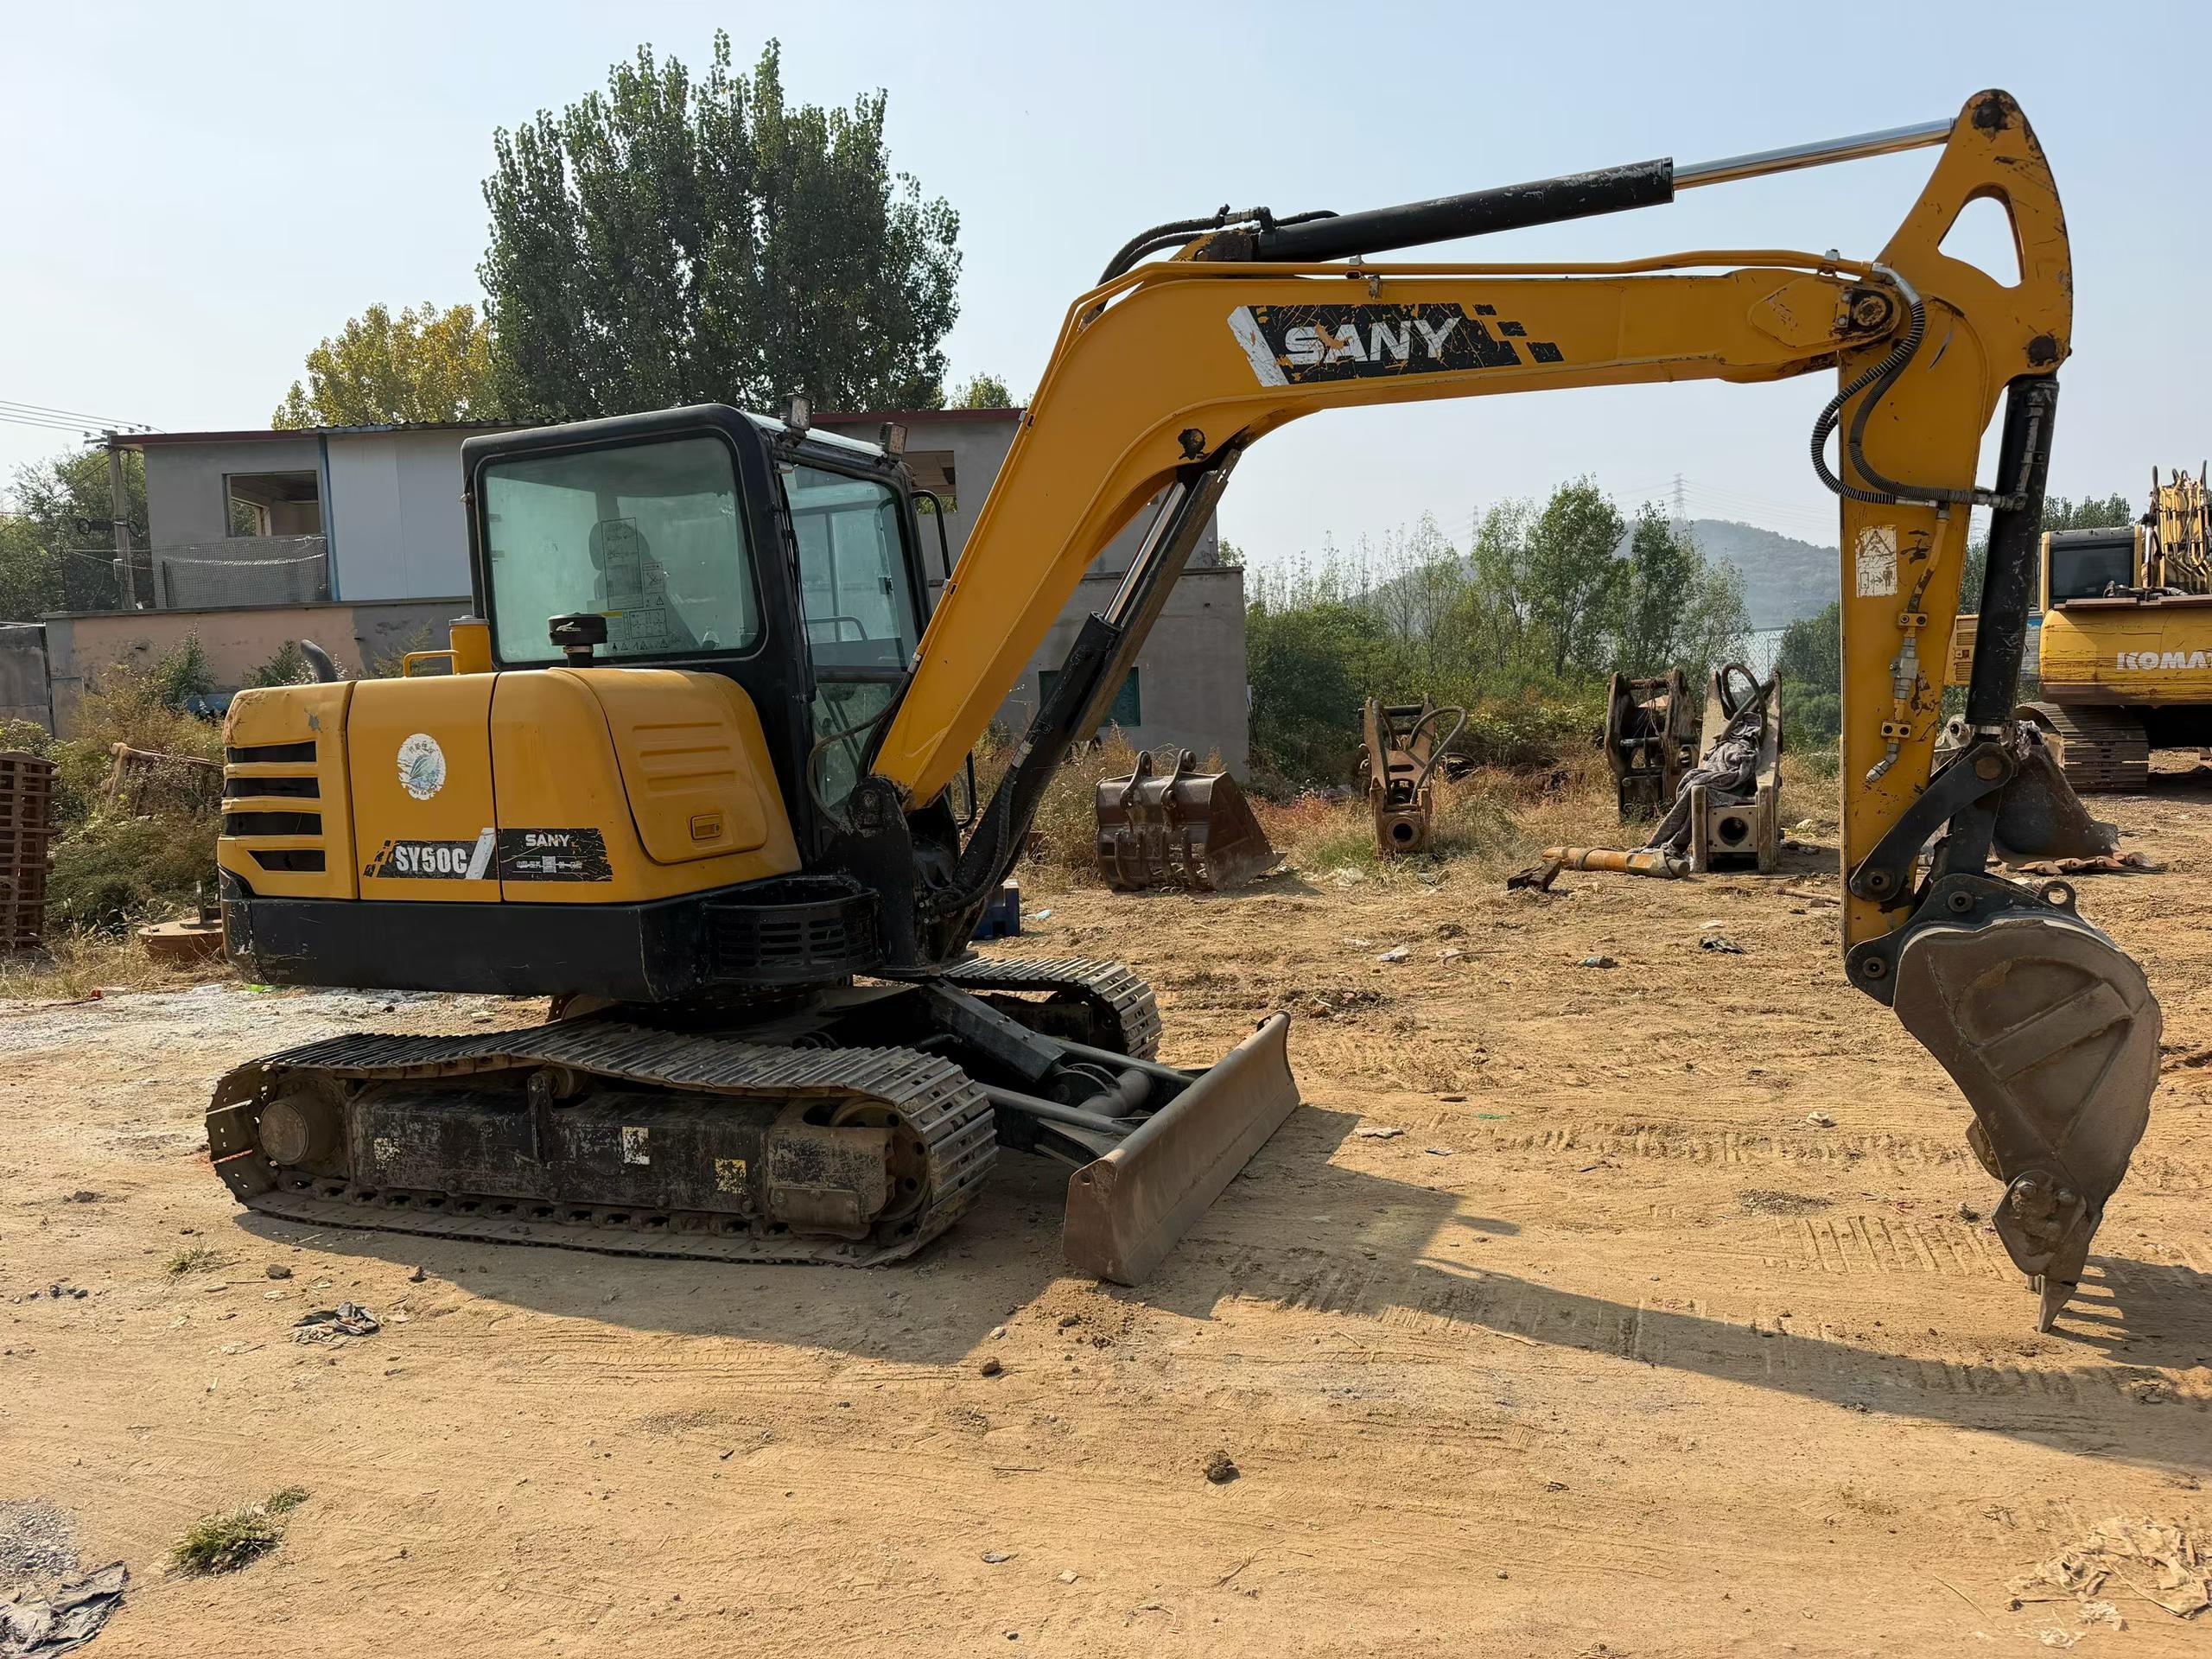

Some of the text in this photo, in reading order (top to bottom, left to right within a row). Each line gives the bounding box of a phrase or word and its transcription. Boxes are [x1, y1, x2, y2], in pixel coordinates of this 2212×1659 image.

[1285, 316, 1461, 365] SANY
[2116, 651, 2212, 670] KOMA
[525, 834, 570, 847] SANY
[395, 846, 467, 874] SY50C
